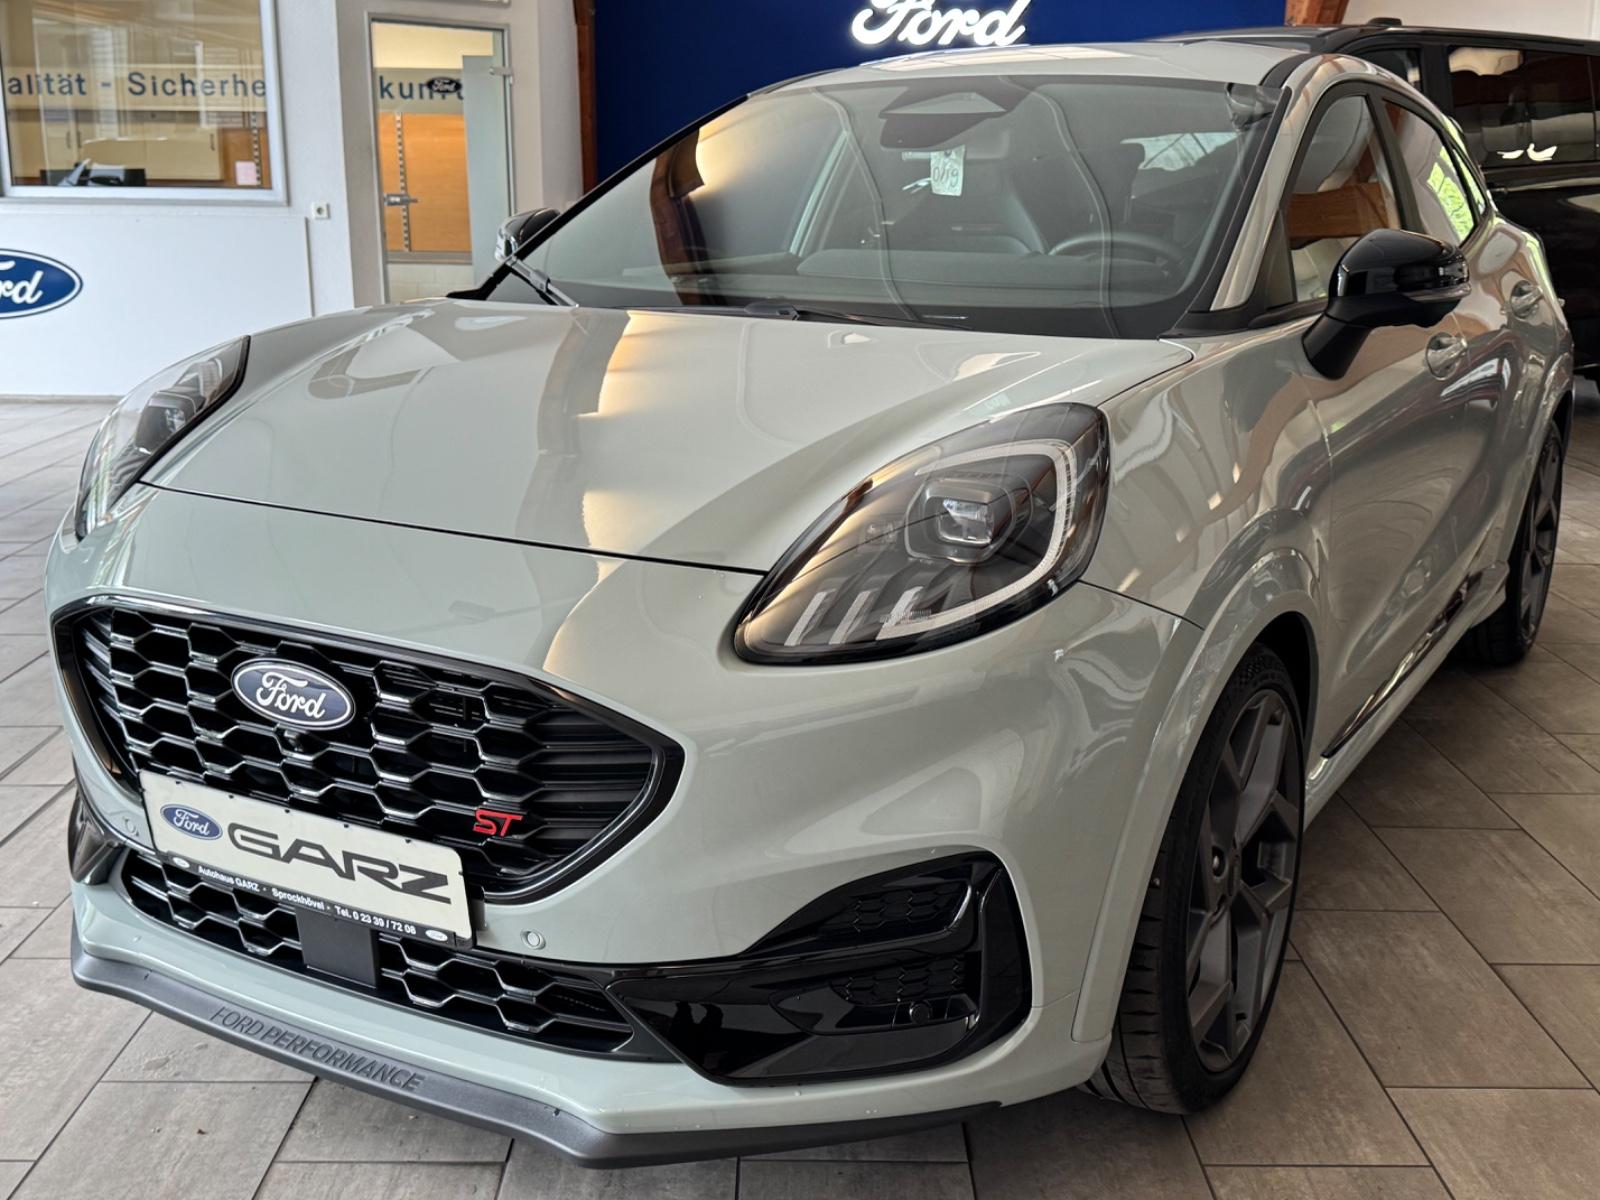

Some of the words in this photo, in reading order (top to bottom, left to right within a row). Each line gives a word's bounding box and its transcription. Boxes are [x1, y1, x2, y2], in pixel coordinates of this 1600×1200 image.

[852, 0, 1029, 46] Ford
[127, 72, 266, 97] Sicherhe
[0, 260, 44, 304] rd
[256, 671, 326, 719] Ford
[171, 808, 211, 837] Ford
[473, 809, 523, 837] ST
[227, 821, 453, 905] GARZ
[198, 865, 235, 885] Autohaus
[235, 877, 260, 892] GARZ
[334, 905, 351, 919] Tel.
[360, 912, 372, 924] 23
[391, 920, 403, 932] 72
[210, 1006, 265, 1036] FORD
[260, 1025, 426, 1092] PERFORMANCE
